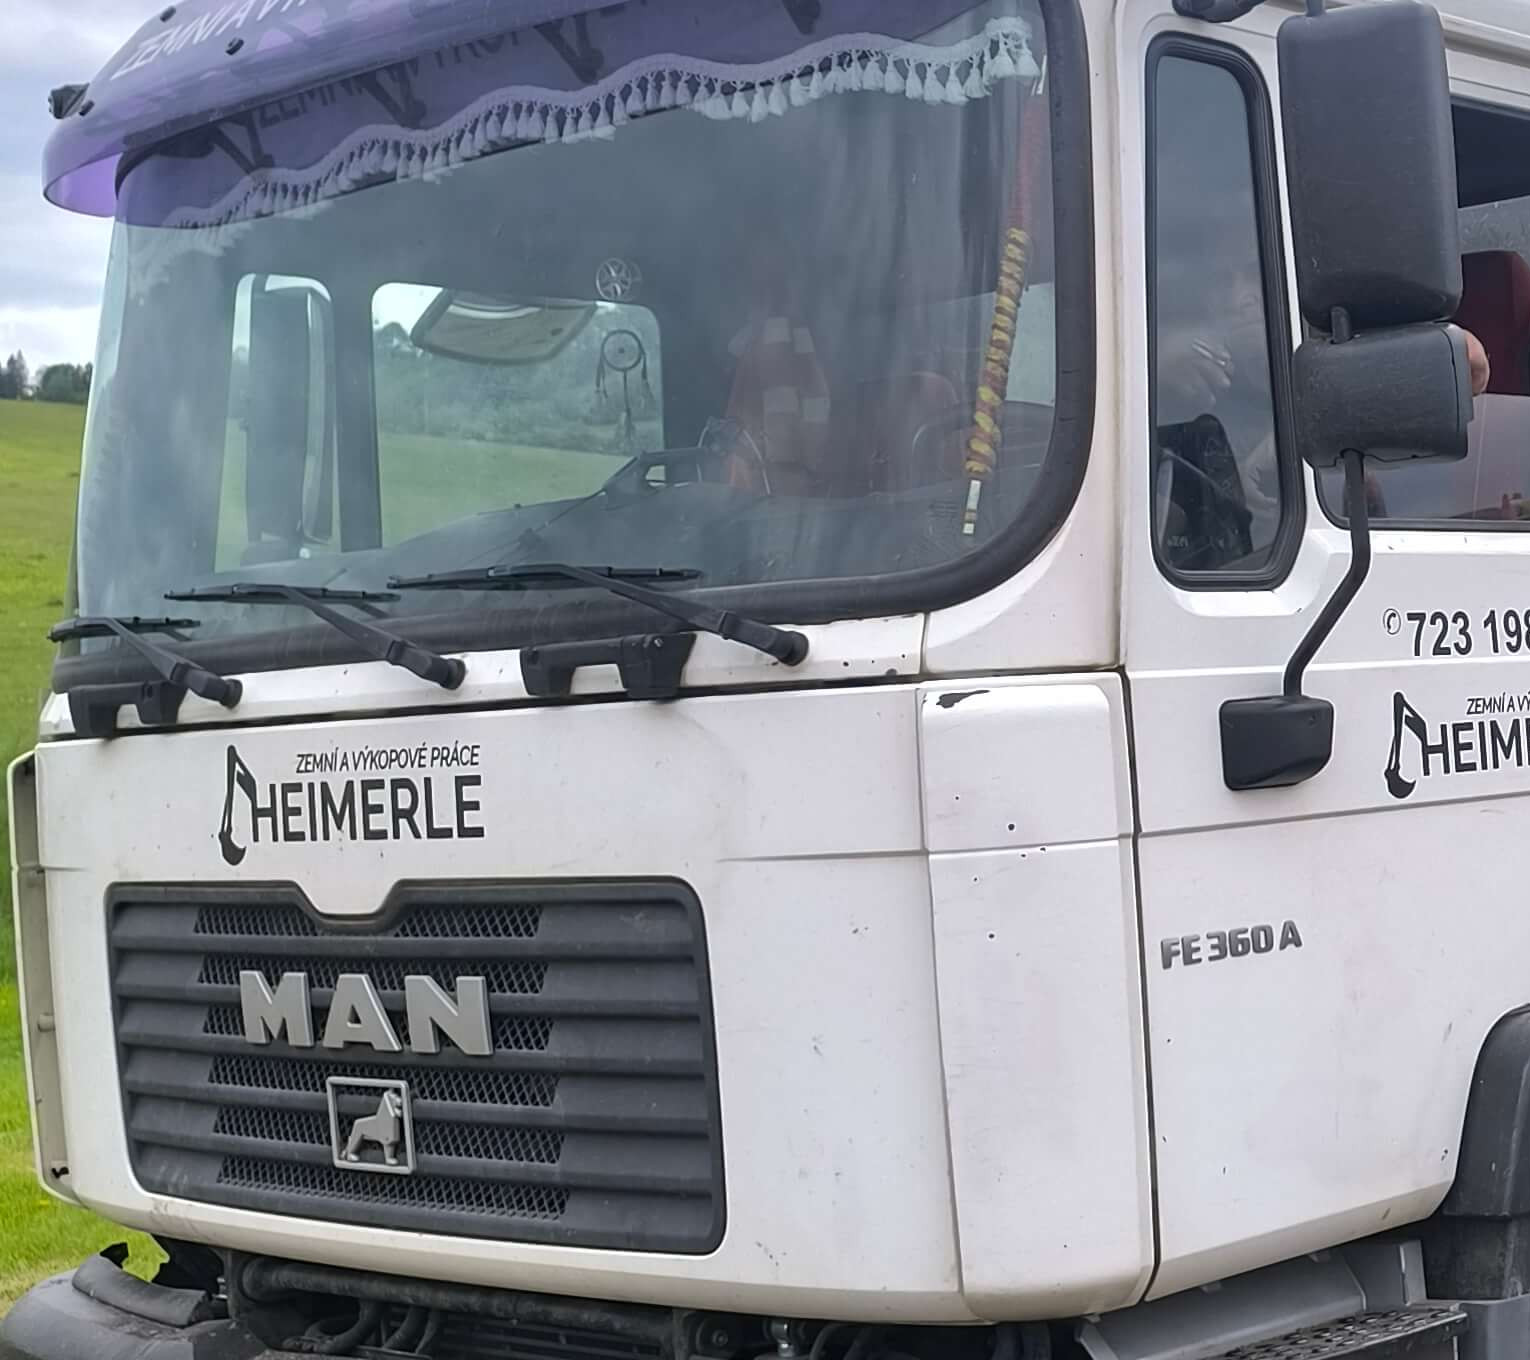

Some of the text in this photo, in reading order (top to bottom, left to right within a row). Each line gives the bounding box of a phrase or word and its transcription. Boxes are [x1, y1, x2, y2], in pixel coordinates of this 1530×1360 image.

[1406, 611, 1473, 656] 723
[1466, 692, 1506, 715] ZEMNÍ
[1507, 697, 1516, 712] A
[296, 739, 480, 773] ZEMNÍ A VÝKOPOVÉ PRÁCE
[250, 774, 485, 842] HEIMERLE
[1160, 920, 1303, 970] FE 360 A
[239, 970, 494, 1056] MAN
